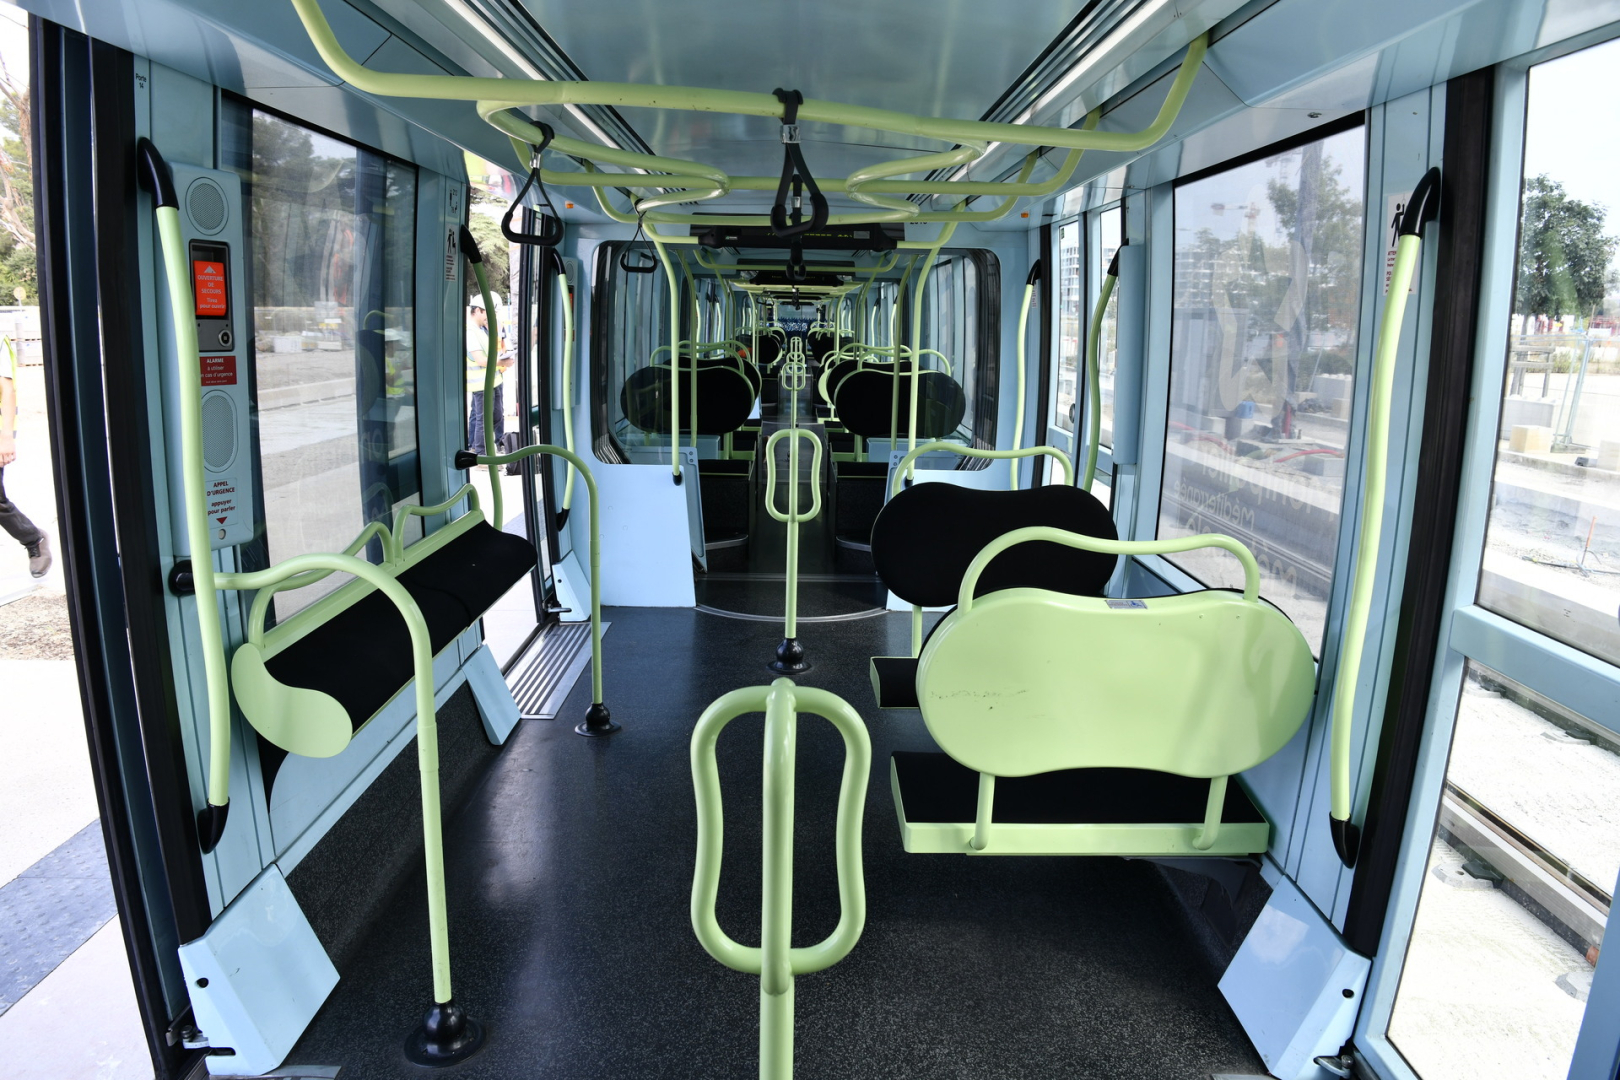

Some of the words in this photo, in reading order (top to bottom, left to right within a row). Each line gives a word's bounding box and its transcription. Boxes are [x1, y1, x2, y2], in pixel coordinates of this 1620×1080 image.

[135, 72, 147, 82] Porte
[207, 487, 235, 496] D'URGENCE
[211, 499, 232, 507] appuyer
